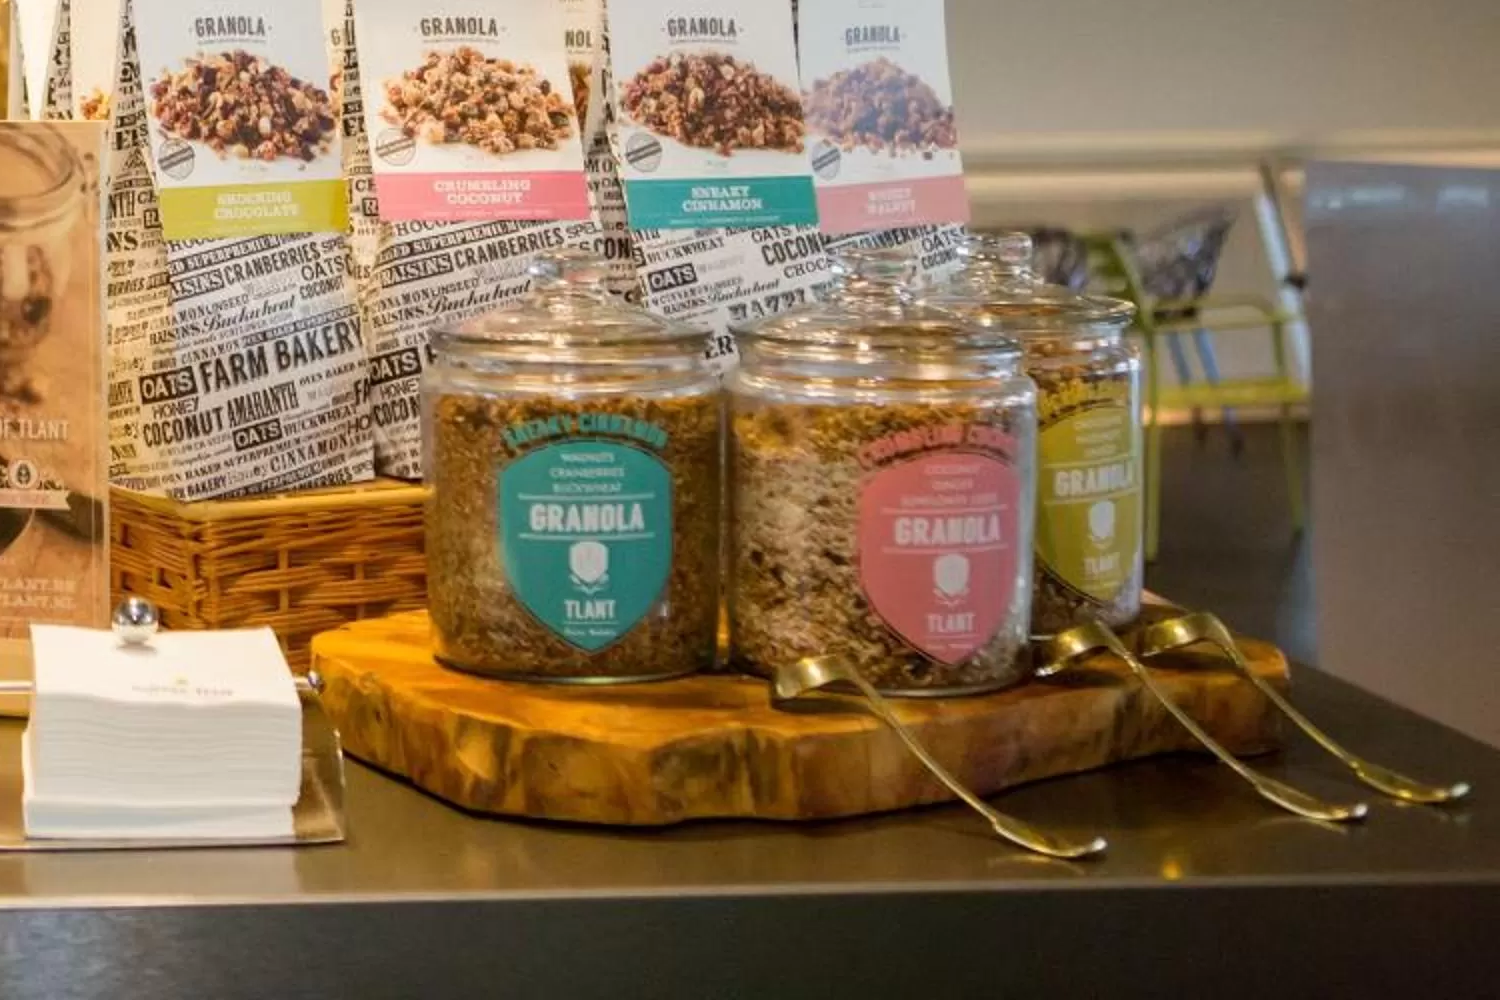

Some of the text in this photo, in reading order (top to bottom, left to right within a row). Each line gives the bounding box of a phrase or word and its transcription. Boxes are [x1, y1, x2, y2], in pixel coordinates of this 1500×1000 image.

[195, 16, 265, 37] GRANOLA
[420, 17, 499, 37] GRANOLA
[667, 18, 737, 37] GRANOLA
[845, 26, 900, 46] GRANOLA
[454, 227, 564, 271] CRANBERRIES
[224, 242, 320, 285] CRANBERRIES
[301, 256, 345, 281] OATS
[650, 265, 695, 290] OATS
[141, 370, 194, 401] OATS
[200, 345, 269, 393] FARM
[276, 317, 364, 371] BAKERY
[381, 378, 420, 399] HONE
[143, 406, 224, 448] COCONUT
[227, 379, 299, 428] AMARANTH
[152, 396, 199, 420] HONEY
[19, 419, 69, 440] TLANT
[235, 421, 279, 446] OATS
[270, 434, 352, 473] CINNAMON
[530, 503, 645, 532] GRANOLA
[894, 515, 1000, 546] GRANOLA
[564, 600, 617, 621] TLANT
[927, 612, 977, 633] TLANT
